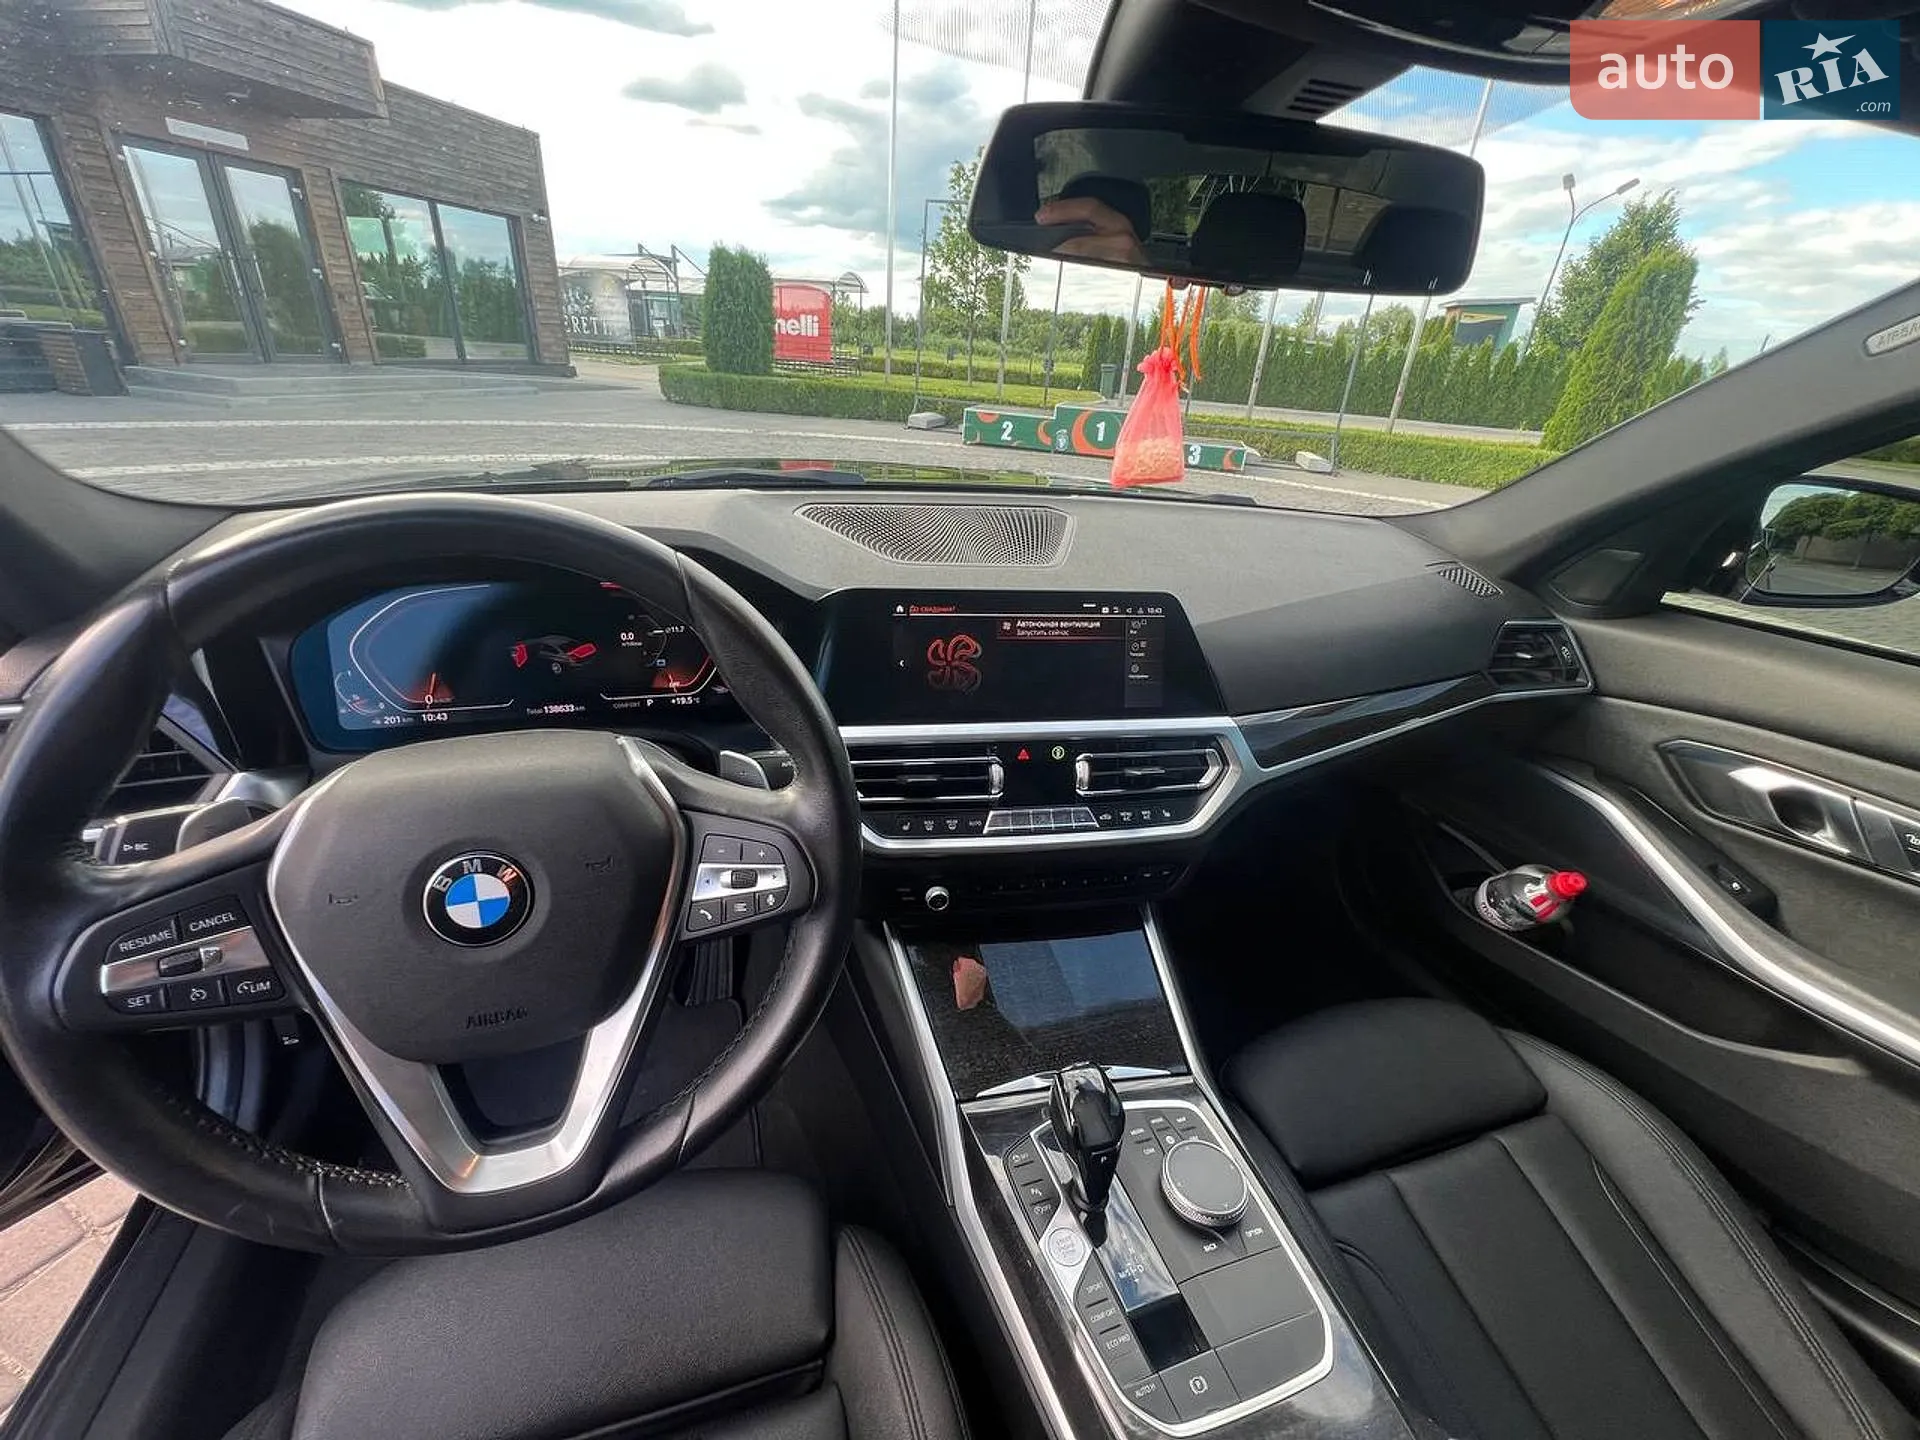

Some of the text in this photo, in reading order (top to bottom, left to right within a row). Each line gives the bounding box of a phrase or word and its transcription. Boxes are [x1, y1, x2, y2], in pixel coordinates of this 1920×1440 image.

[1001, 421, 1014, 441] 2
[1096, 421, 1105, 442] 1
[1188, 445, 1202, 465] 3
[1016, 620, 1100, 629] Автономная вентиляция
[620, 632, 634, 641] 0.0
[1016, 629, 1047, 637] Запустить
[424, 694, 434, 705] 0
[646, 698, 654, 707] P
[383, 715, 400, 725] 201
[422, 712, 448, 722] 10:43
[432, 858, 518, 893] BMW
[189, 911, 237, 932] CANCEL
[119, 929, 173, 953] RESUME
[249, 980, 271, 994] LIM
[127, 994, 152, 1008] SET
[466, 1007, 529, 1030] AIRBAG
